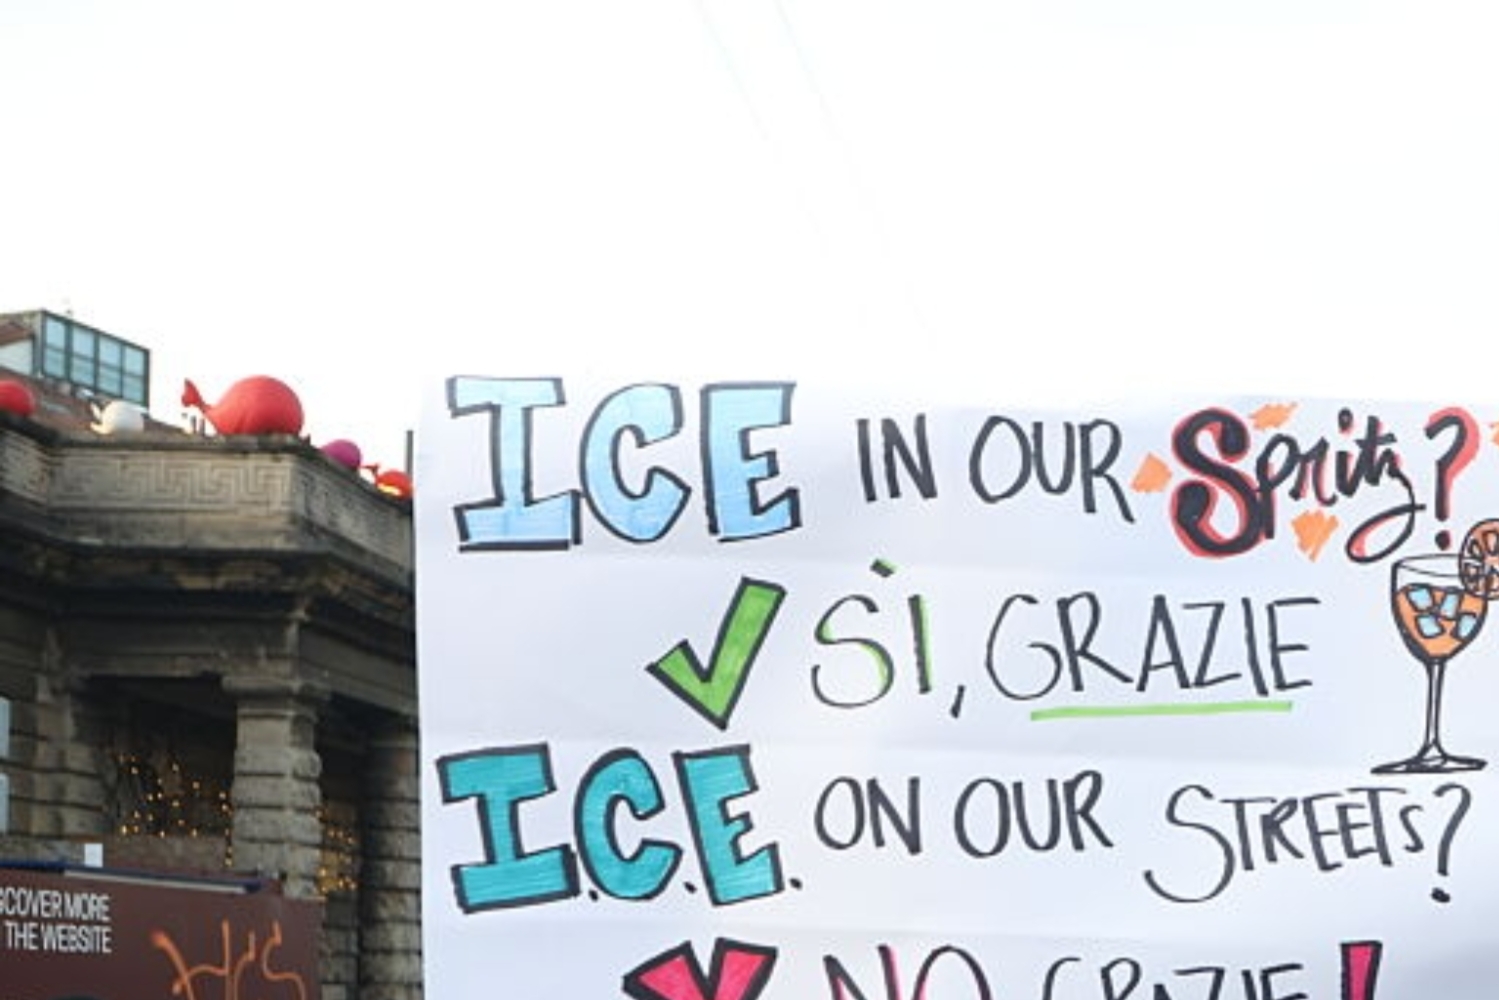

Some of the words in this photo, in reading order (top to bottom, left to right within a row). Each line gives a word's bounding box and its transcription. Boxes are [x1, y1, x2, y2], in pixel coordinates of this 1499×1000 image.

[446, 376, 802, 553] ICE
[857, 413, 938, 503] IN
[969, 415, 1136, 524] OUR
[985, 591, 1321, 701] GRAZIE
[436, 742, 803, 914] I.C.E.
[814, 776, 923, 855] ON
[954, 770, 1114, 858] OUR
[4, 920, 39, 951] THE
[40, 922, 113, 954] WEBSITE
[64, 891, 111, 922] MORE
